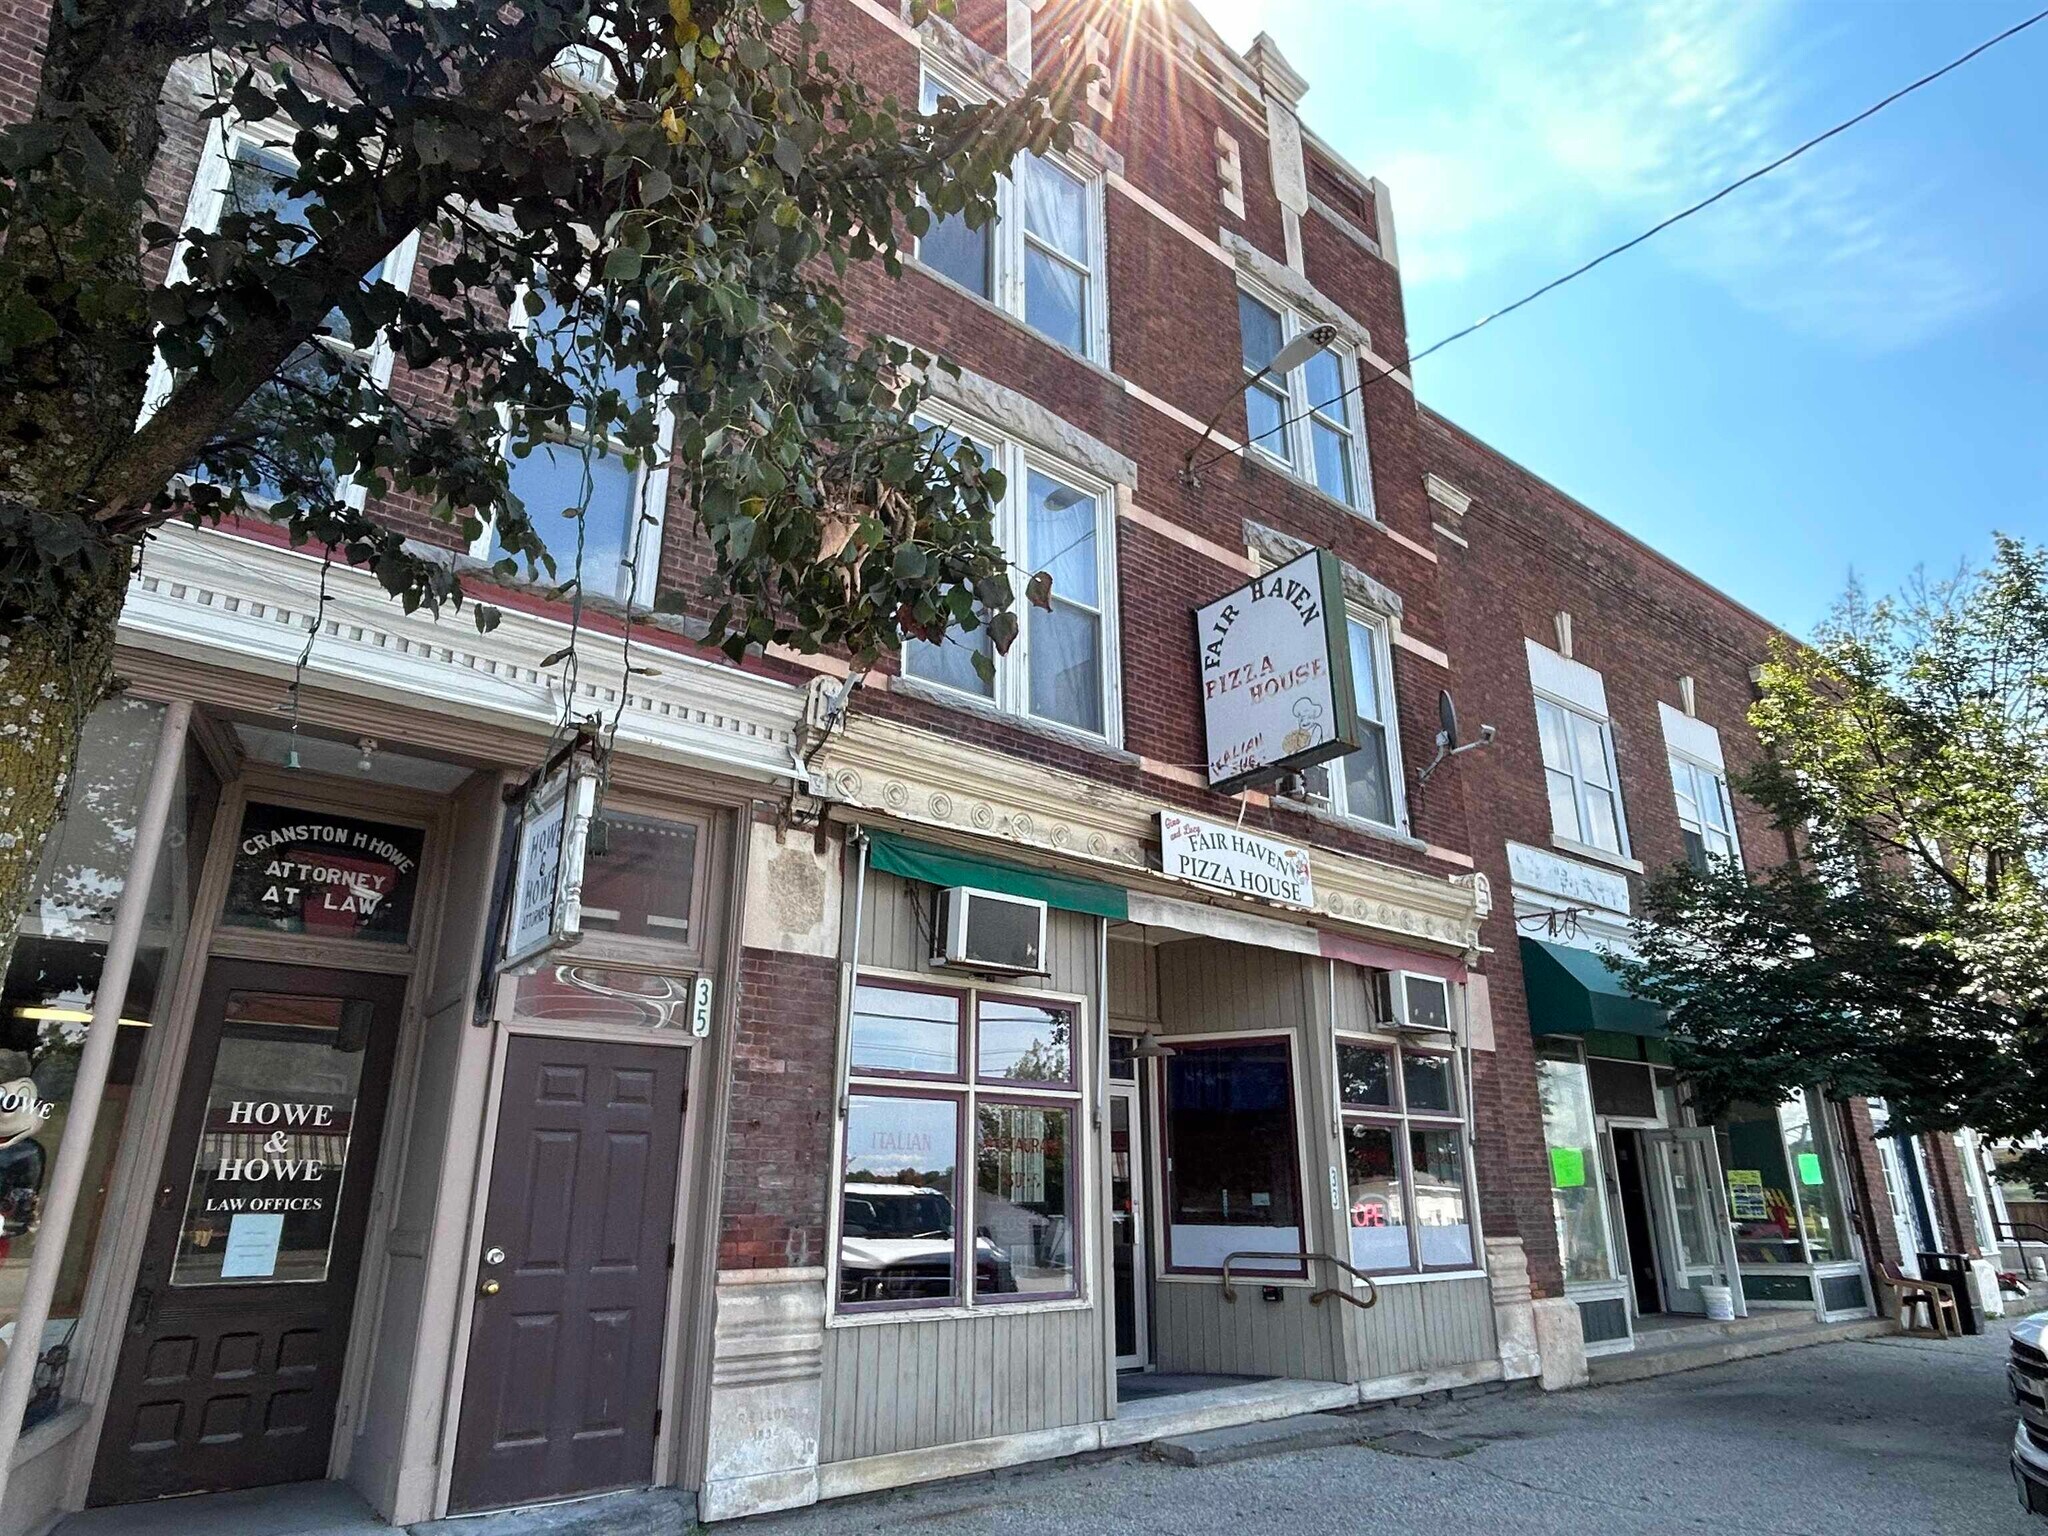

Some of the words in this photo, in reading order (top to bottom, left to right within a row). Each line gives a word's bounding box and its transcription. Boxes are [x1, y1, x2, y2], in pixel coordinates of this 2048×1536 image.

[1204, 603, 1240, 671] FAIR
[1250, 576, 1320, 627] HAVEN
[1205, 655, 1275, 700] PIZZA
[1249, 658, 1326, 704] HOUSE
[1164, 817, 1181, 829] Gino
[1170, 827, 1182, 841] and
[1183, 823, 1201, 836] Lucy
[242, 824, 349, 856] CRANSTON
[352, 832, 368, 848] H
[368, 837, 415, 875] HOWE
[529, 821, 562, 867] HOWE
[1189, 832, 1228, 852] FAIR
[1231, 834, 1291, 877] HAVEN
[264, 860, 387, 890] ATTORNEY
[524, 866, 558, 910] HOWE
[1178, 853, 1236, 886] PIZZA
[1239, 869, 1302, 902] HOUSE
[261, 885, 301, 905] AT
[324, 893, 379, 915] LAW
[695, 983, 709, 1032] 35
[1, 1092, 55, 1120] OWE
[227, 1101, 334, 1127] HOWE
[263, 1130, 289, 1153] &
[871, 1130, 932, 1152] ITALIAN
[216, 1158, 323, 1182] HOWE
[205, 1198, 247, 1212] LAW
[249, 1197, 323, 1211] OFFICES
